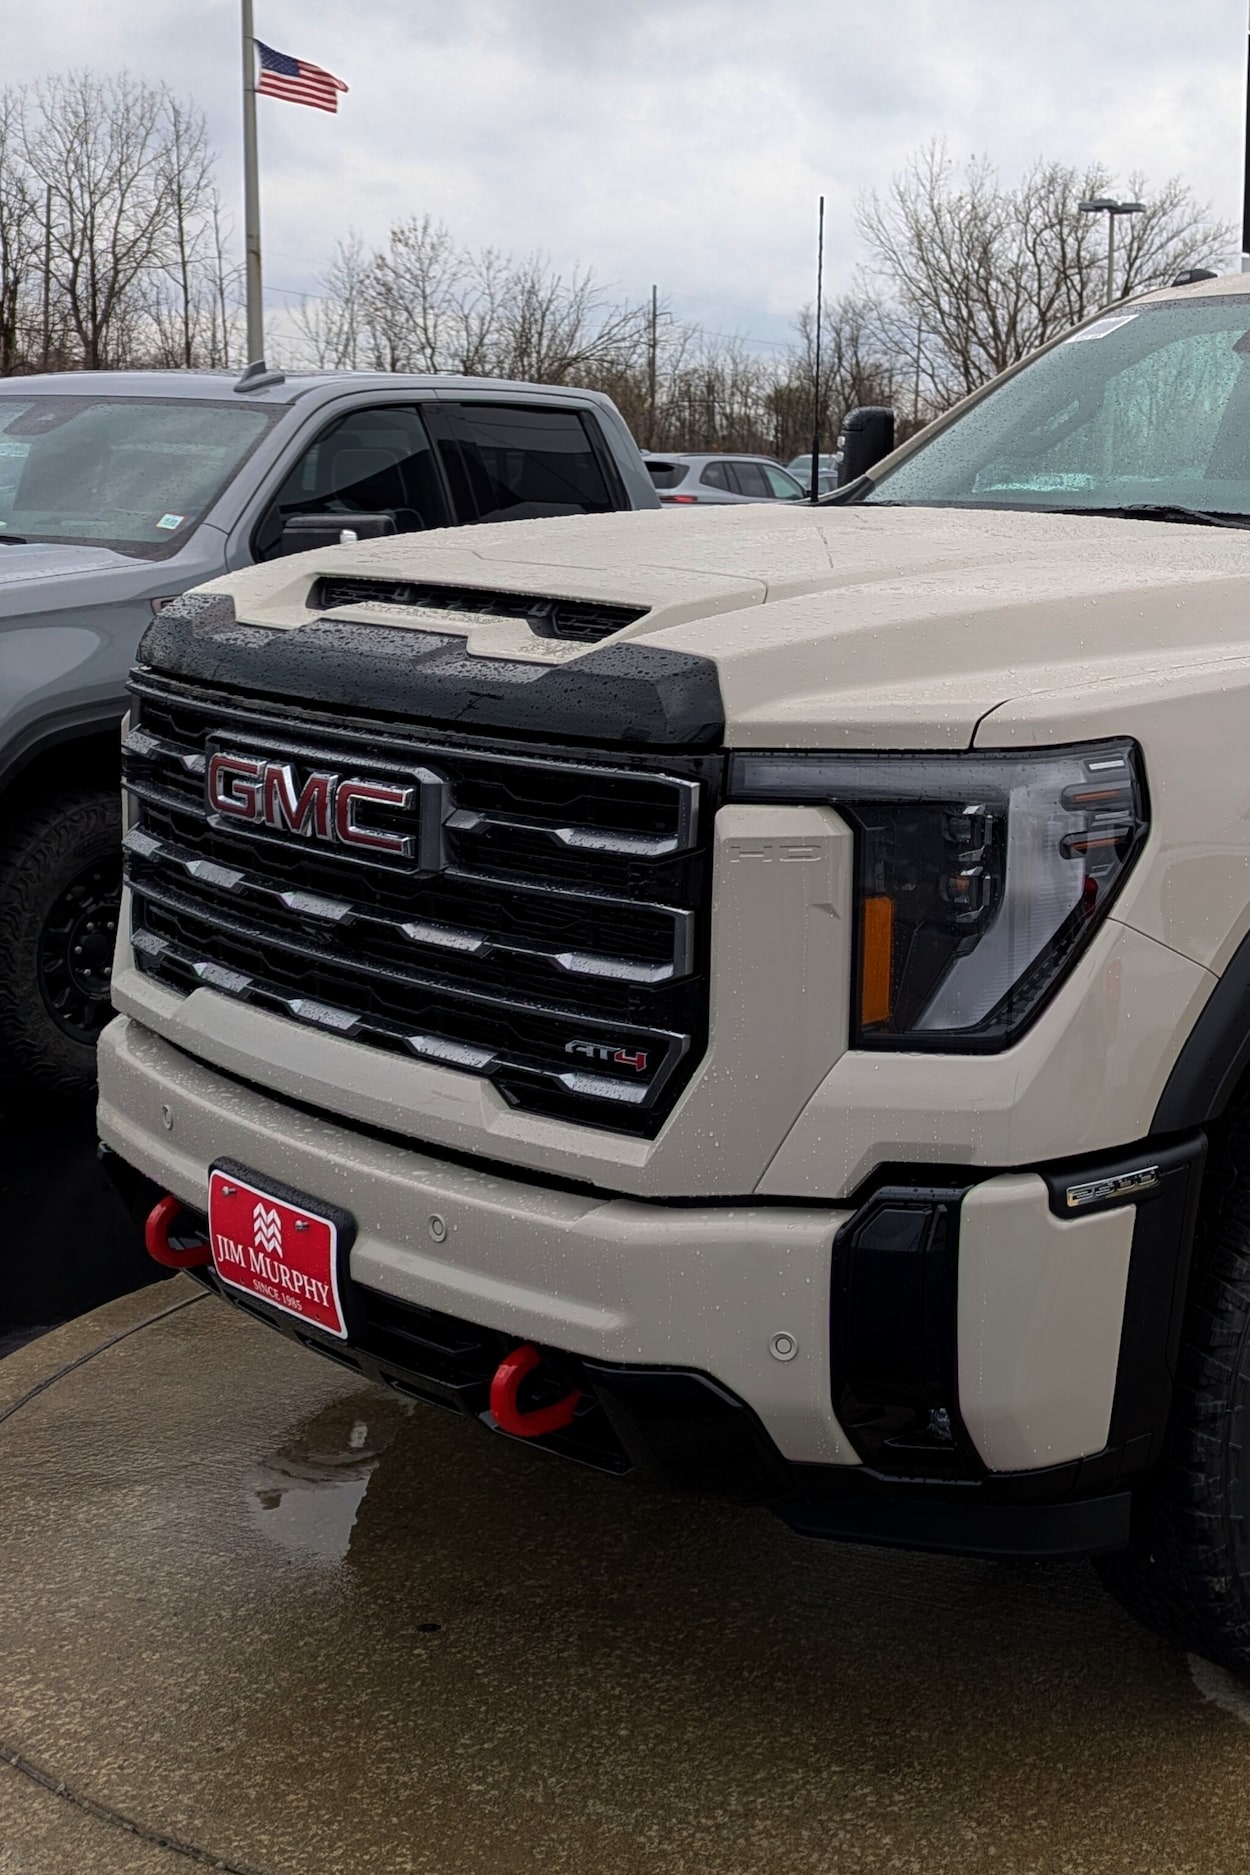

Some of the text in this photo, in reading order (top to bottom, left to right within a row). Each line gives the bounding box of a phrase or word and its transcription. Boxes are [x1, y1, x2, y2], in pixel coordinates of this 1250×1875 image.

[208, 752, 417, 859] GMC
[730, 845, 821, 863] HD
[564, 1039, 648, 1073] AT4
[216, 1233, 330, 1308] JIM MURPHY
[252, 1278, 303, 1312] SINCE 1985
